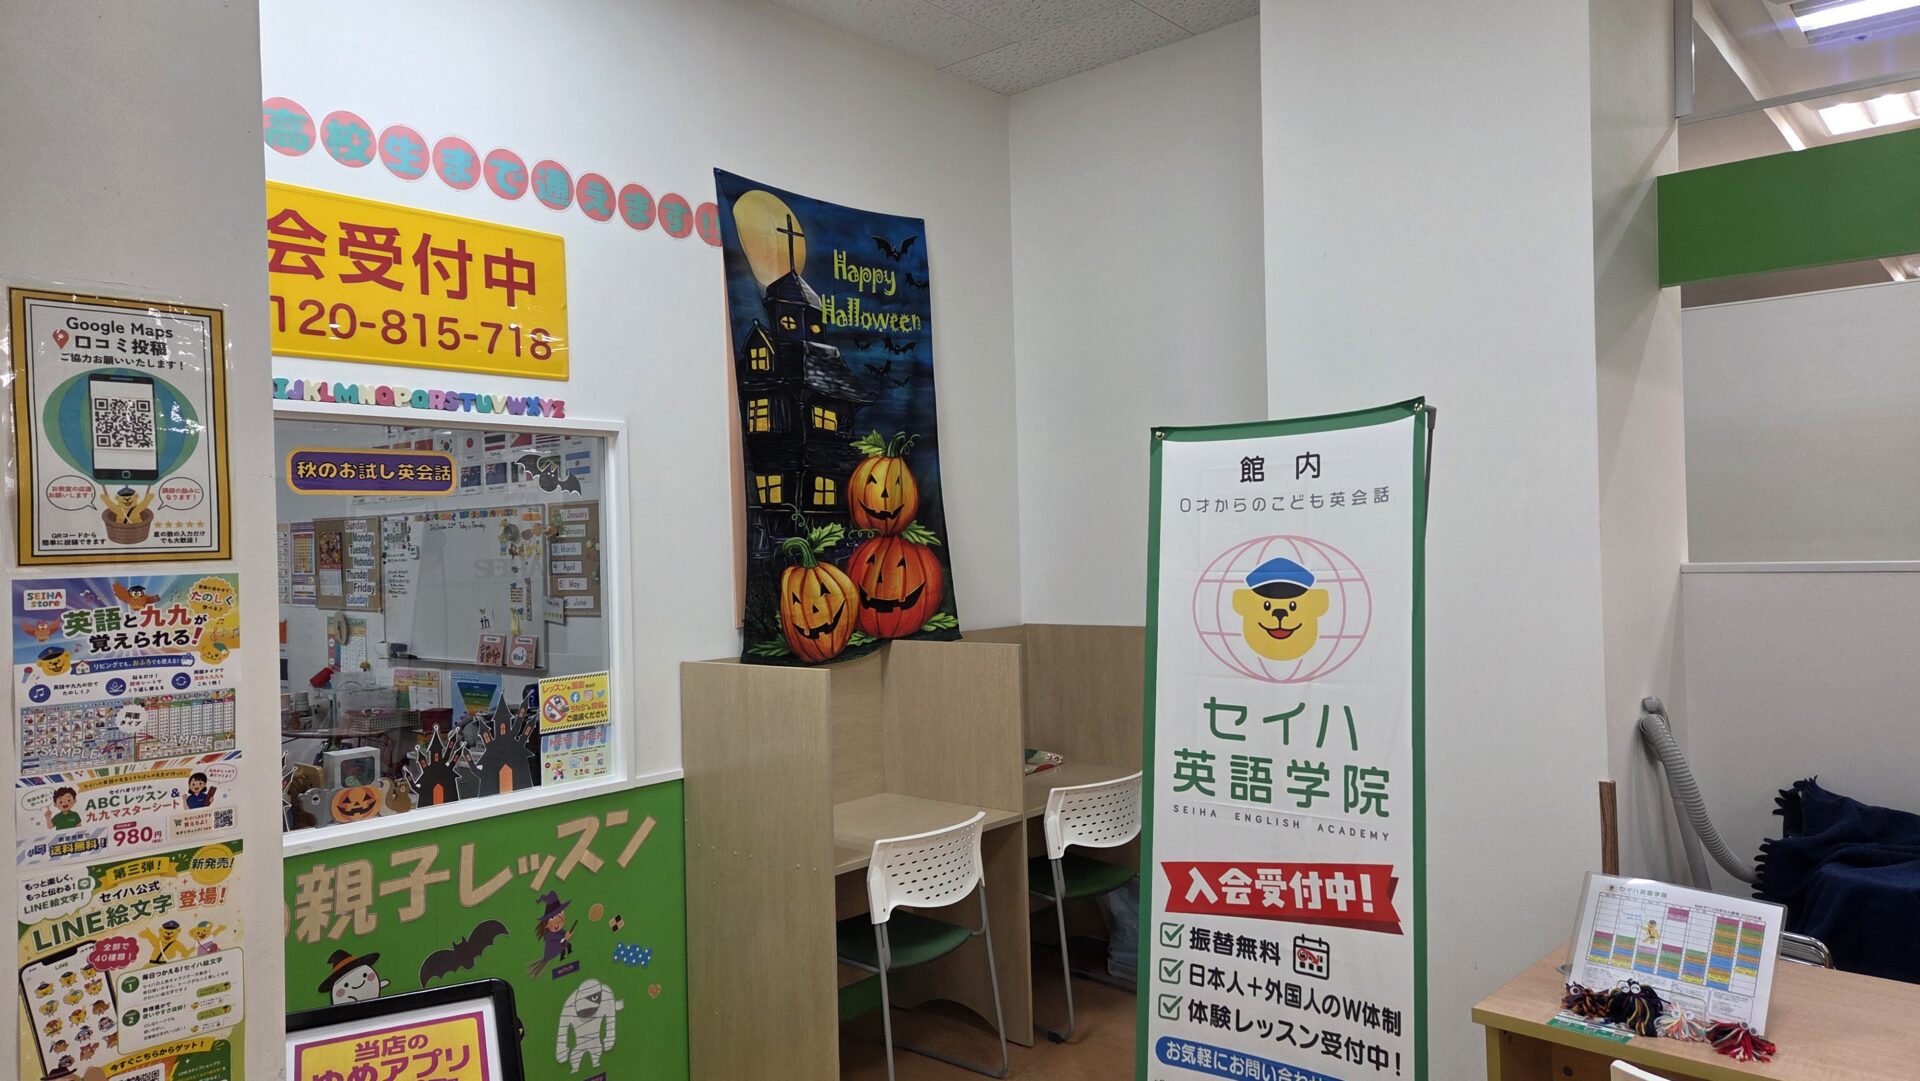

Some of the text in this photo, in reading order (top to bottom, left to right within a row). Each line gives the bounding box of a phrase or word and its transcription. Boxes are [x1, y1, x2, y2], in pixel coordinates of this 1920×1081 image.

[267, 208, 536, 307] 会受付中
[833, 249, 896, 295] Happy
[821, 294, 921, 333] Halloween
[66, 317, 173, 339] Google Maps
[75, 335, 167, 356] 口コミ投稿
[297, 461, 451, 482] 秋のお試し英会話
[1180, 486, 1389, 513] 0才からのこども英会話
[353, 533, 375, 544] Monday
[27, 591, 63, 600] SEIHA
[191, 591, 233, 606] たのしく
[353, 583, 375, 594] Friday
[31, 599, 61, 608] store
[63, 604, 207, 636] 英語と九九が
[88, 627, 202, 652] 覚えられる!
[1203, 696, 1358, 751] セイハ
[160, 734, 213, 746] SAMPLE
[40, 746, 98, 759] SAMPLE
[109, 785, 152, 795] セイハオリジナル
[1173, 748, 1390, 818] 英語学院
[86, 800, 180, 822] 九九マスターシート
[1173, 804, 1390, 842] SEIHA ENGLISH ACADEMY
[50, 838, 107, 857] 送料無料!
[113, 860, 162, 880] 第三弾!
[191, 857, 235, 870] 新発売!
[284, 809, 657, 944] 親子レッスン
[26, 883, 76, 901] もっと伝わる!
[100, 881, 161, 903] セイハ公式
[179, 887, 227, 909] 登場!
[1184, 866, 1374, 913] 入会受付中!
[24, 892, 85, 915] LINE絵文字!
[103, 942, 130, 951] 全部で
[1189, 927, 1281, 967] 振替無料
[55, 962, 69, 970] LINE
[558, 965, 574, 974] witch
[1189, 963, 1402, 1037] 日本人+外国人のW体制
[354, 1034, 429, 1062] 当店の
[1188, 999, 1401, 1076] 体験レッスン受付中!
